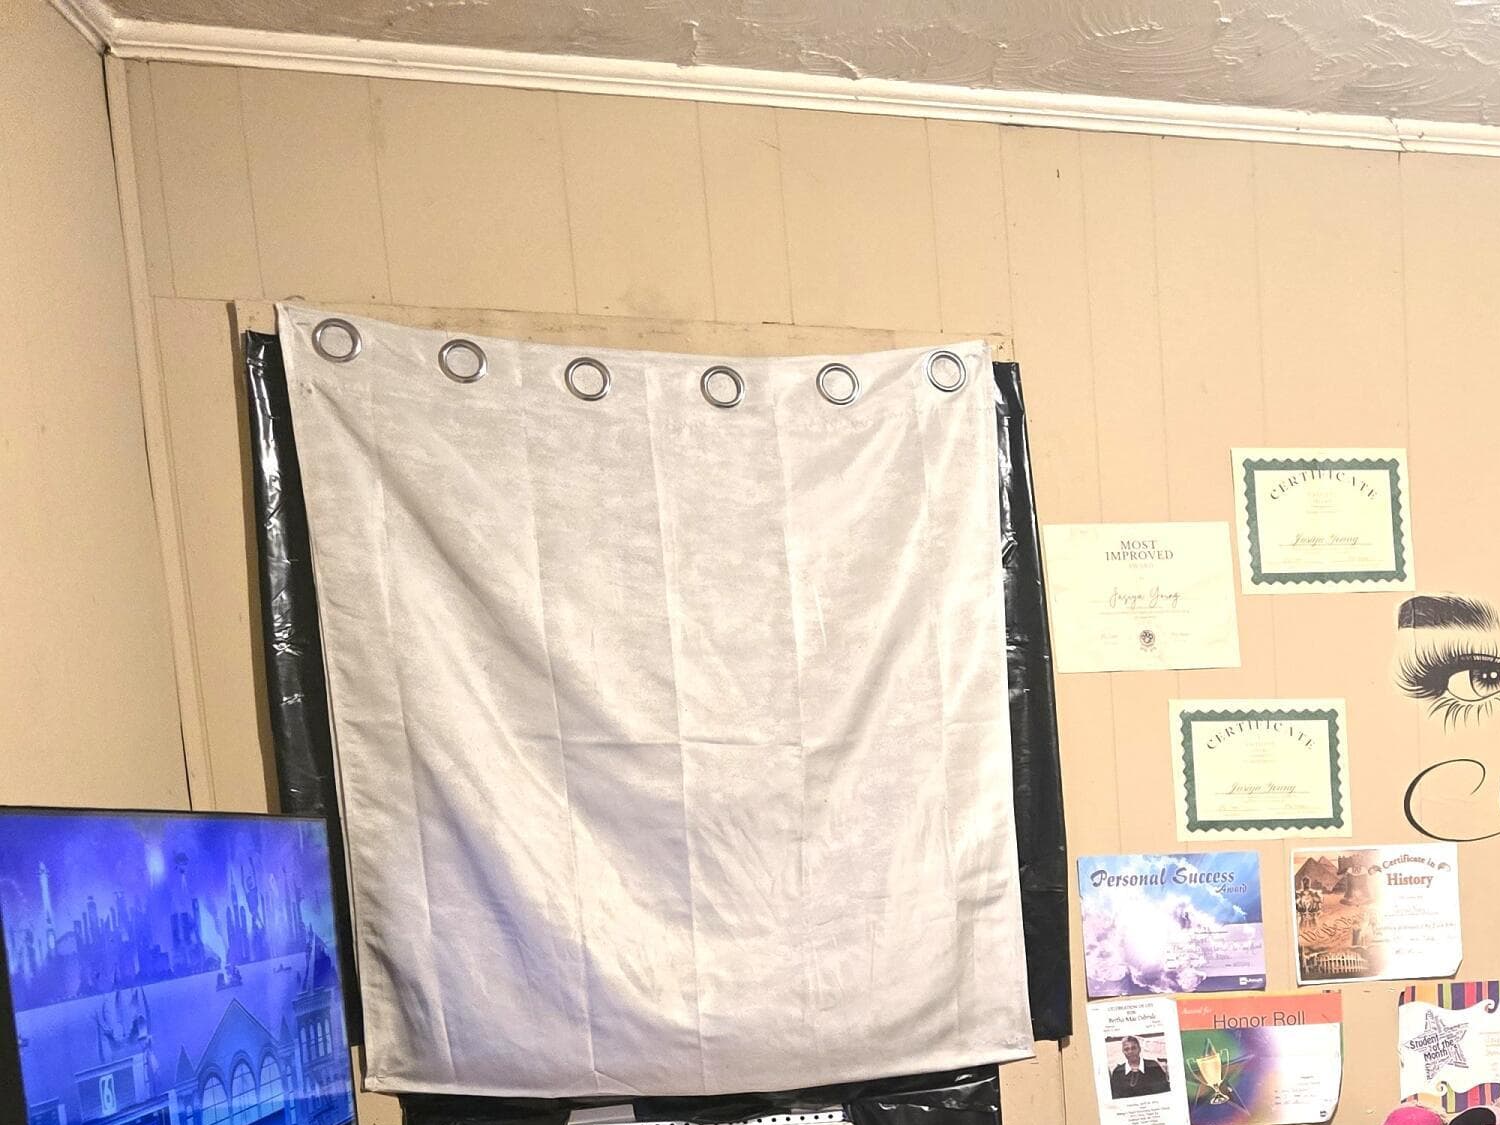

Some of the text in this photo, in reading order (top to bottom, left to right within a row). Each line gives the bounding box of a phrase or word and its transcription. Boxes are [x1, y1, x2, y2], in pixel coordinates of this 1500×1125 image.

[1270, 469, 1378, 500] CERTIFICATE
[1120, 539, 1156, 550] MOST
[1105, 550, 1174, 561] IMPROVED
[1206, 720, 1316, 750] CERTIFICATE
[1382, 854, 1436, 870] Certificate in
[1090, 867, 1235, 887] Personal Success
[1387, 873, 1434, 888] History
[1215, 884, 1248, 894] Award
[1213, 1011, 1305, 1030] Honor Roll
[1410, 1034, 1439, 1050] Student
[1433, 1038, 1454, 1051] of the
[1424, 1049, 1449, 1062] Month
